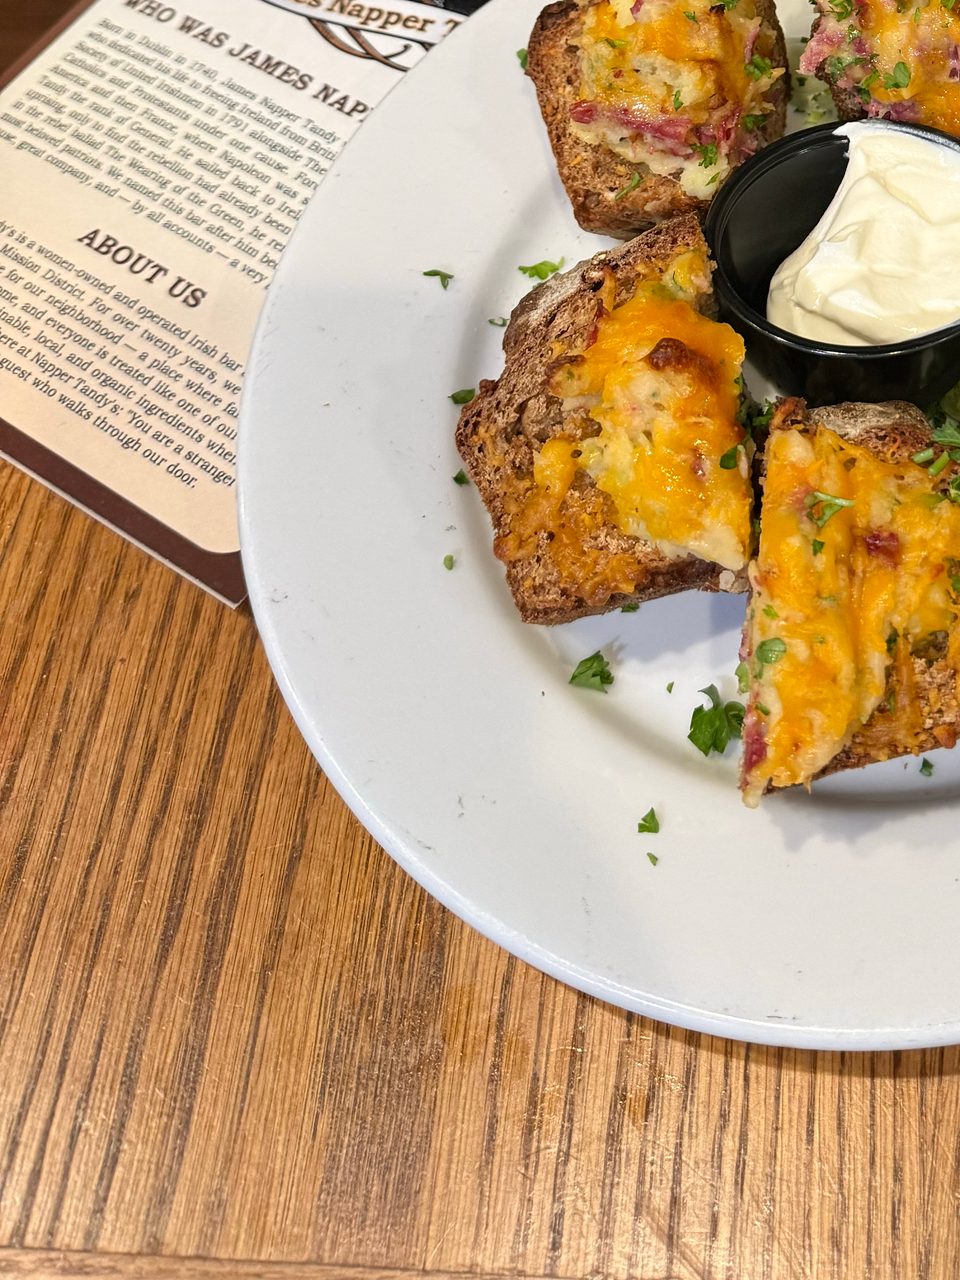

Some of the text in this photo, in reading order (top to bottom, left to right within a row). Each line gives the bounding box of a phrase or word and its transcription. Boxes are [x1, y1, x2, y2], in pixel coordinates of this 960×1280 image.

[178, 16, 229, 48] WAS
[228, 44, 313, 90] JAMES
[312, 84, 373, 122] NAP
[220, 78, 257, 100] James
[259, 96, 301, 122] Napper
[302, 118, 340, 144] Tandy
[175, 146, 194, 160] He
[194, 158, 230, 180] sailed
[231, 176, 260, 197] back
[183, 132, 217, 153] where
[218, 150, 271, 184] Napoleon
[275, 182, 297, 198] was
[193, 119, 228, 139] under
[254, 152, 288, 175] cause.
[219, 112, 249, 132] 1791
[248, 130, 303, 161] alongside
[238, 104, 281, 130] Ireland
[278, 126, 308, 145] from
[307, 141, 337, 161] Briti
[44, 155, 92, 186] company,
[94, 181, 120, 197] and
[131, 200, 148, 215] by
[146, 211, 165, 223] all
[162, 220, 215, 253] accounts
[241, 264, 268, 284] very
[104, 145, 126, 162] The
[127, 157, 172, 189] Wearing
[186, 192, 207, 207] the
[208, 203, 244, 232] Green,
[248, 226, 267, 241] he
[106, 165, 123, 180] We
[122, 177, 164, 201] named
[161, 198, 185, 215] this
[184, 209, 207, 226] bar
[205, 224, 235, 243] after
[233, 237, 259, 257] him
[145, 151, 194, 180] rebellion
[193, 175, 220, 193] had
[218, 190, 262, 219] already
[262, 212, 292, 235] been
[37, 245, 116, 294] women-owned
[112, 291, 140, 309] and
[137, 306, 191, 340] operated
[188, 334, 218, 358] Irish
[218, 352, 243, 371] bar
[78, 229, 207, 308] ABOUT US
[0, 243, 242, 395] Mission District. For over twenty years, we
[4, 269, 24, 284] for
[23, 281, 46, 297] our
[44, 295, 124, 344] neighborhood
[147, 358, 183, 382] place
[185, 379, 222, 406] where
[20, 302, 48, 320] and
[45, 317, 96, 351] everyone
[109, 355, 154, 386] treated
[151, 380, 176, 401] like
[176, 398, 201, 416] one
[30, 352, 74, 383] Napper
[73, 378, 124, 416] Tandy's:
[127, 409, 152, 434] "You
[151, 430, 174, 448] are
[32, 377, 57, 397] who
[58, 393, 93, 420] walks
[92, 416, 142, 452] through
[142, 448, 167, 466] our
[166, 463, 198, 488] door.
[33, 330, 65, 358] local,
[65, 353, 93, 371] and
[91, 368, 136, 399] organic
[136, 394, 205, 443] ingredients
